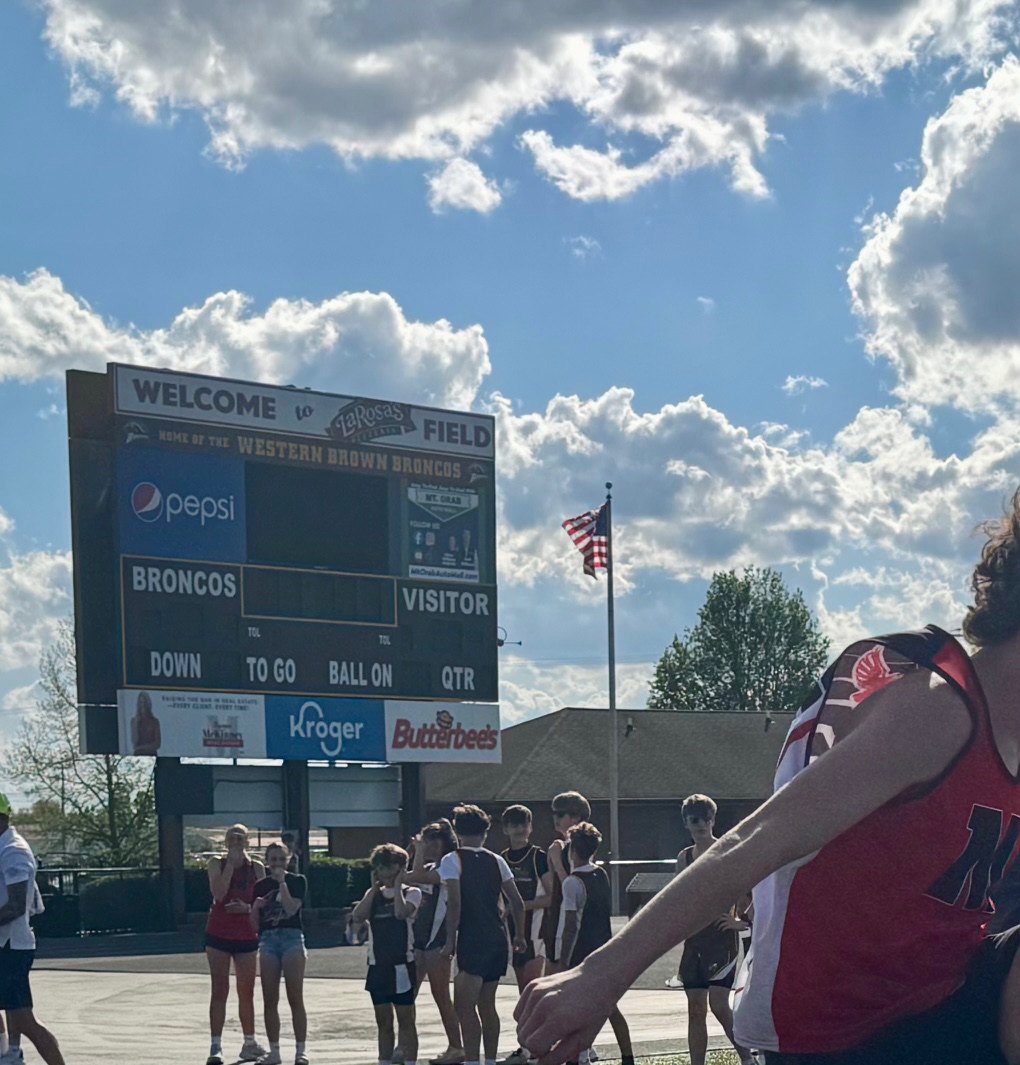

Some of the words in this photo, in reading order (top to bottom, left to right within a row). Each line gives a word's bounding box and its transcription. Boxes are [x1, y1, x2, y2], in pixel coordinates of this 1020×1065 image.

[131, 378, 276, 420] WELCOME
[423, 418, 492, 448] FIELD
[159, 430, 189, 443] HOME
[192, 433, 205, 445] OF
[209, 436, 230, 448] THE
[237, 435, 322, 464] WESTERN
[327, 447, 388, 471] BROWN
[392, 455, 461, 479] BRONCOS
[166, 493, 235, 526] pepsi
[132, 565, 236, 598] BRONCOS
[402, 587, 489, 616] VISITOR
[248, 626, 261, 637] TOL
[379, 634, 391, 645] TOL
[150, 651, 202, 679] DOWN
[246, 657, 268, 682] TO
[273, 658, 296, 684] GO
[329, 660, 368, 686] BALL
[371, 662, 392, 688] ON
[441, 665, 475, 691] QTR
[290, 701, 364, 757] Kroger
[392, 718, 499, 750] Butterbee's
